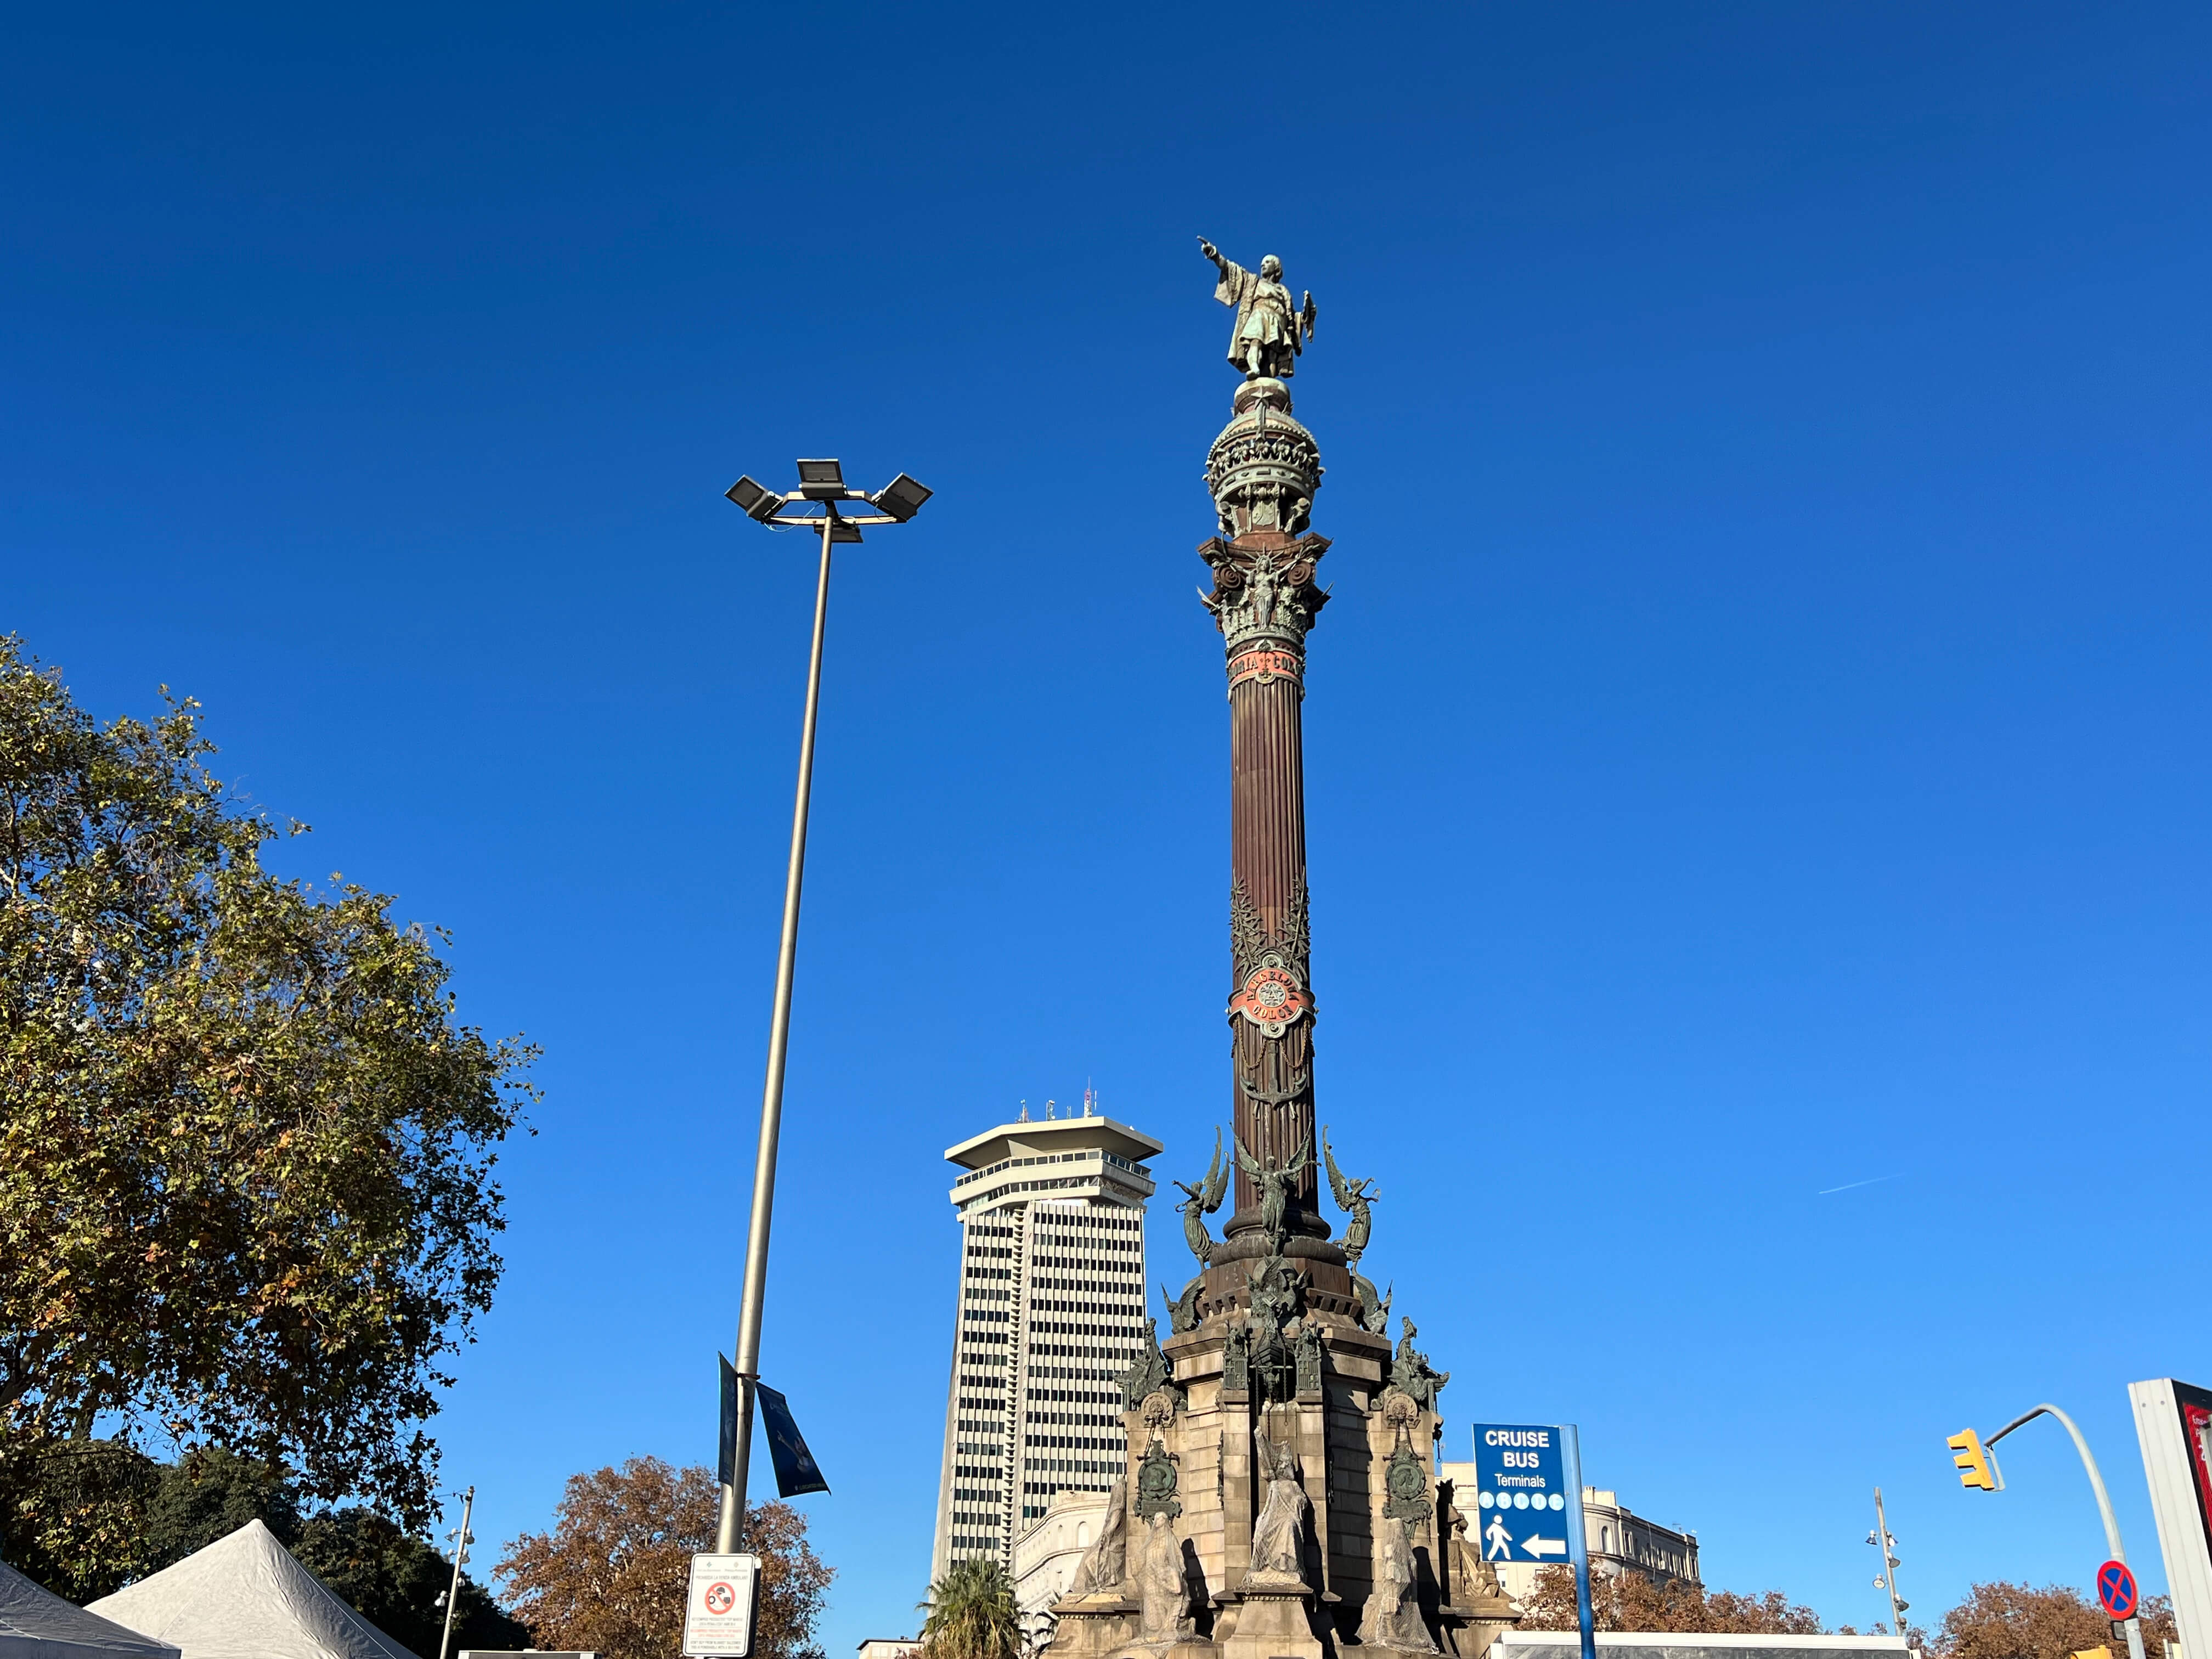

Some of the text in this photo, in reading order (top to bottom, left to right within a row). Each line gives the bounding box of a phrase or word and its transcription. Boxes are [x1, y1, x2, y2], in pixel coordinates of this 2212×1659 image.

[1485, 1430, 1550, 1448] CRUISE
[1503, 1452, 1539, 1469] BUS
[1494, 1473, 1546, 1488] Terminals
[1482, 1494, 1560, 1508] A B C D E
